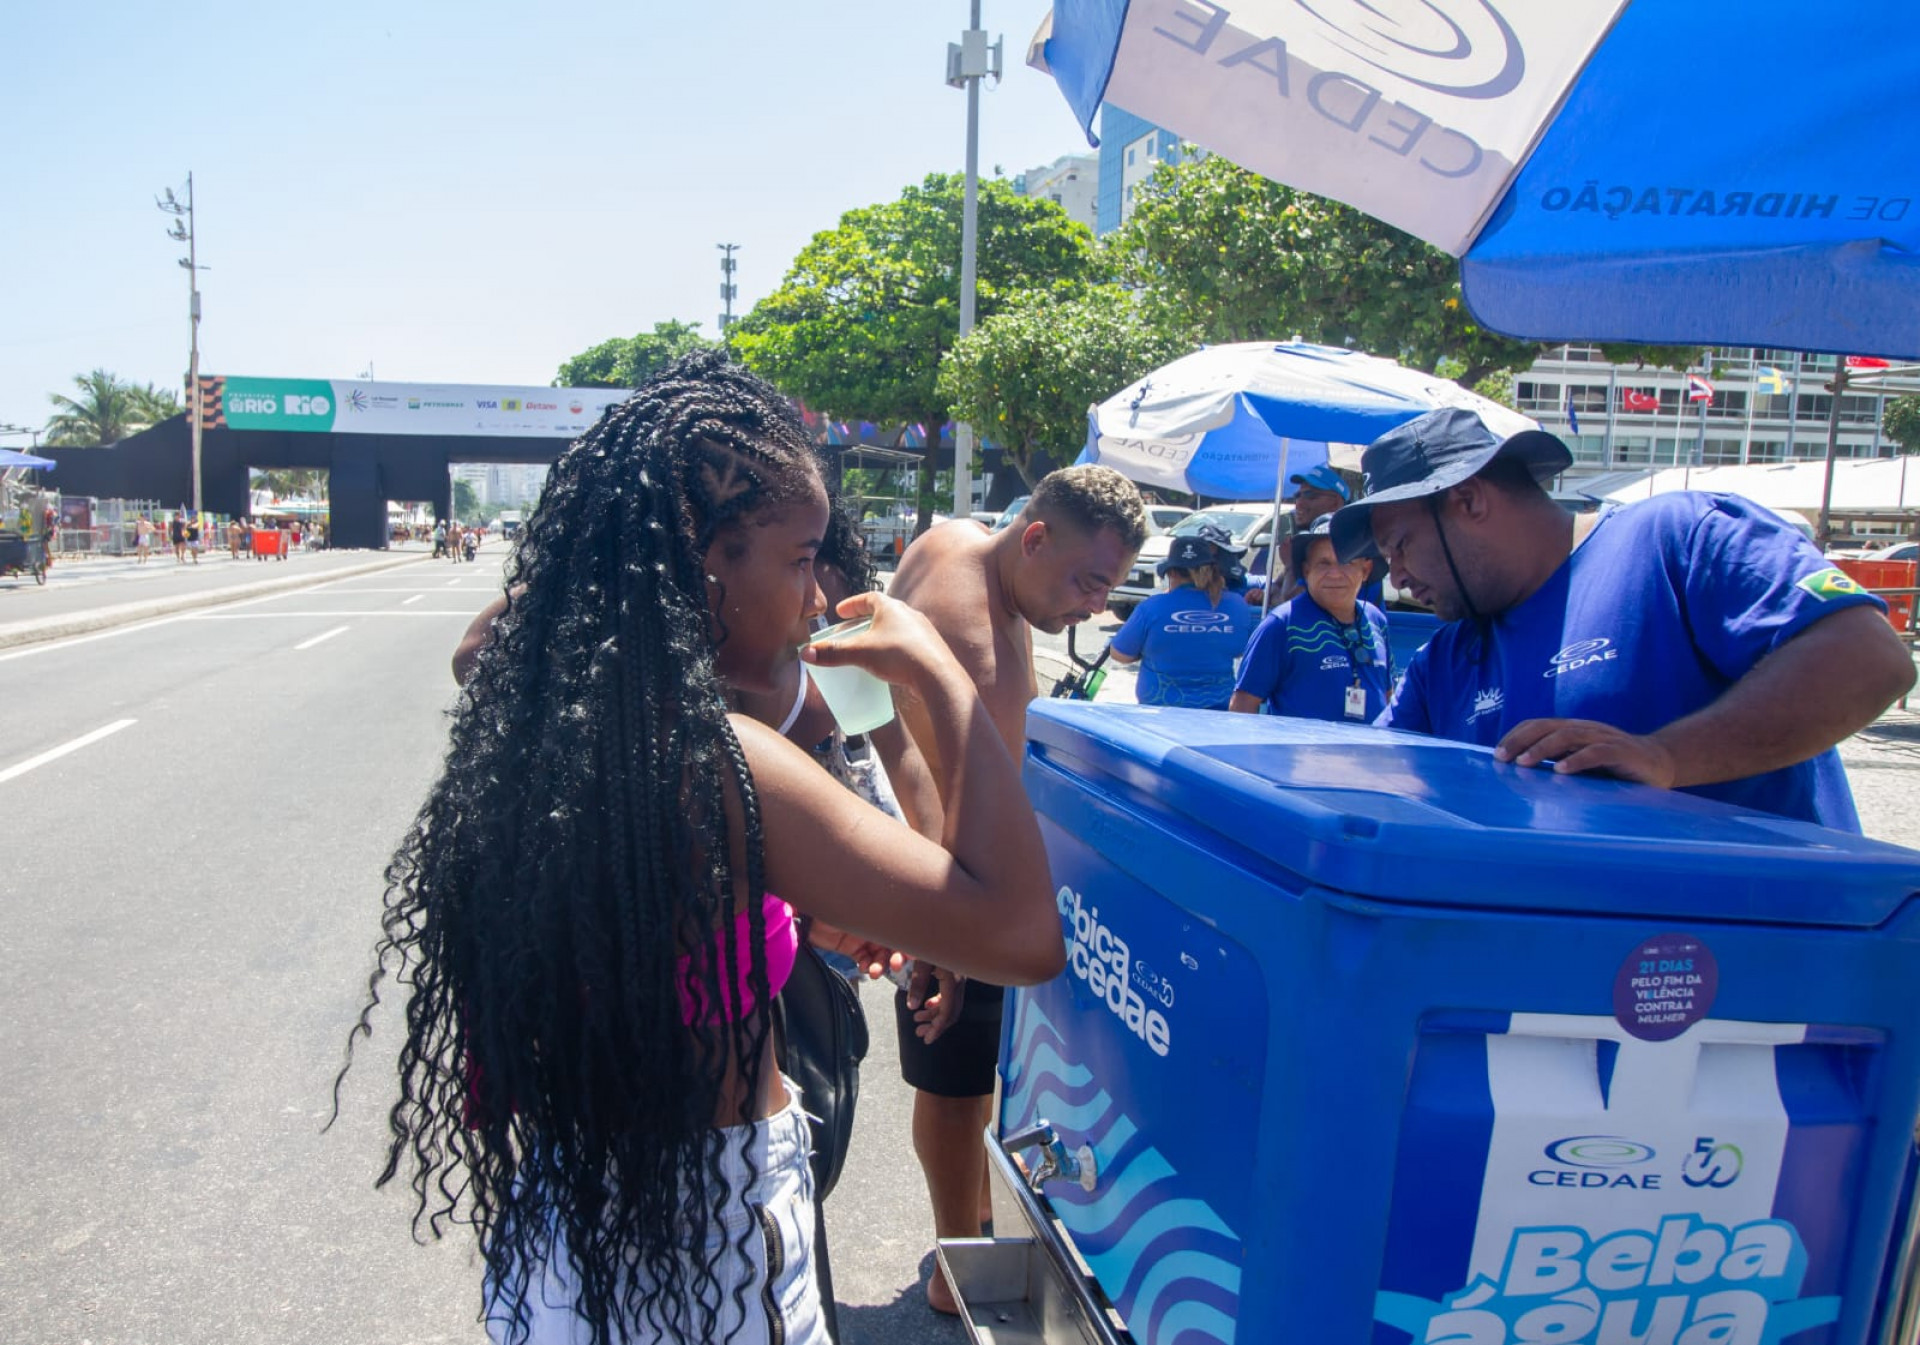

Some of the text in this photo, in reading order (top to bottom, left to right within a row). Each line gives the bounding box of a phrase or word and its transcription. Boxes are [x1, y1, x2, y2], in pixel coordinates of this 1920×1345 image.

[245, 399, 277, 414] RIO
[476, 400, 497, 409] VISA
[1163, 624, 1234, 633] CEDAE
[1543, 649, 1618, 678] CEDAE
[1074, 892, 1130, 976] bica
[1639, 959, 1694, 973] 21 DIAS
[1631, 974, 1702, 987] PELO FIM DA
[1072, 942, 1171, 1057] cedae
[1635, 1000, 1693, 1012] CONTRA A
[1637, 1013, 1686, 1023] MULHER
[1528, 1170, 1661, 1189] CEDAE
[1503, 1218, 1793, 1296] Beba
